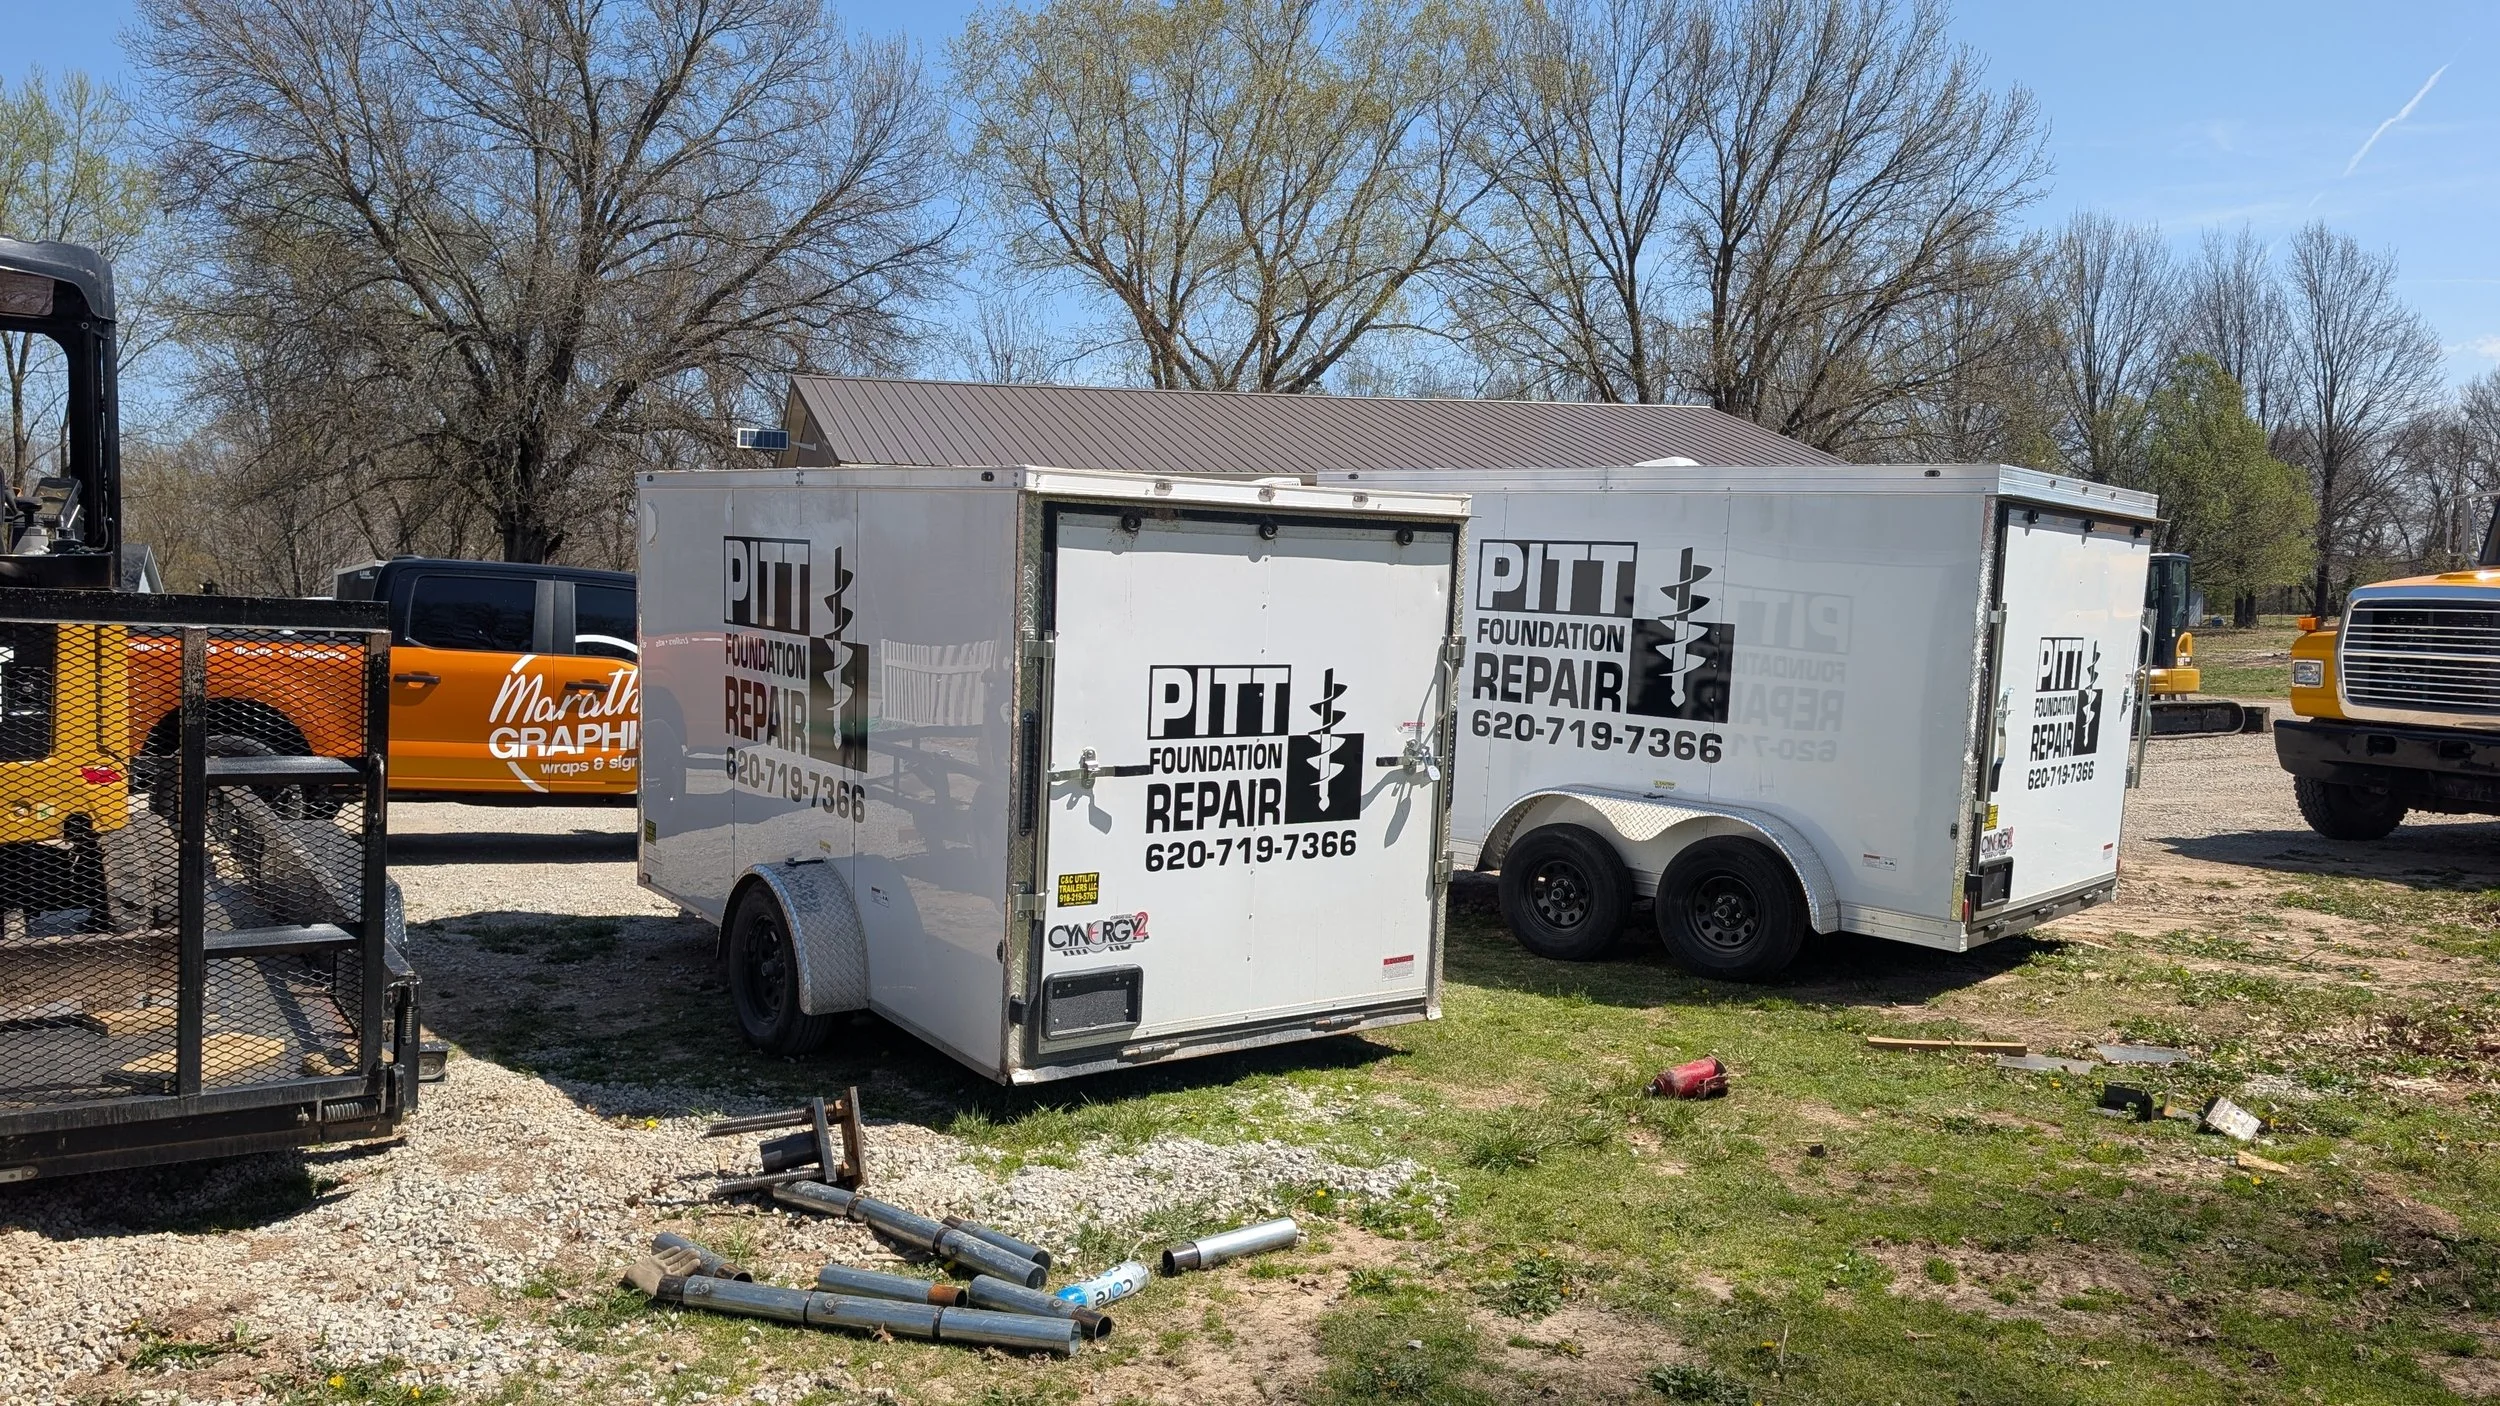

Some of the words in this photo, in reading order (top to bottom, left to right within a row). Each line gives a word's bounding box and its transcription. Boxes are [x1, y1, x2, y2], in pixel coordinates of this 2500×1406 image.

[723, 537, 811, 634] PITT
[1479, 540, 1636, 616] PITT
[726, 632, 806, 680] FOUNDATION
[1477, 618, 1625, 653] FOUNDATION
[1473, 652, 1623, 713] REPAIR
[2037, 638, 2083, 691] PITT
[489, 668, 638, 723] Marath
[725, 676, 806, 756] REPAIR
[1149, 666, 1290, 738] PITT
[2034, 696, 2077, 718] FOUNDATION
[488, 720, 638, 759] GRAPHI
[1150, 743, 1282, 774] FOUNDATION
[1472, 709, 1722, 764] 620-719-7366
[2030, 724, 2074, 762] REPAIR
[541, 761, 589, 776] wraps
[593, 757, 604, 771] &
[726, 746, 865, 823] 620-719-7366
[2028, 761, 2094, 790] 620-719-7366
[1146, 778, 1282, 834] REPAIR
[1146, 829, 1357, 872] 620-719-7366
[1059, 884, 1088, 894] TRAILERS
[1089, 883, 1098, 891] LLC
[1060, 876, 1074, 885] C&C
[1074, 874, 1098, 883] UTILITY
[1095, 1278, 1134, 1307] core
